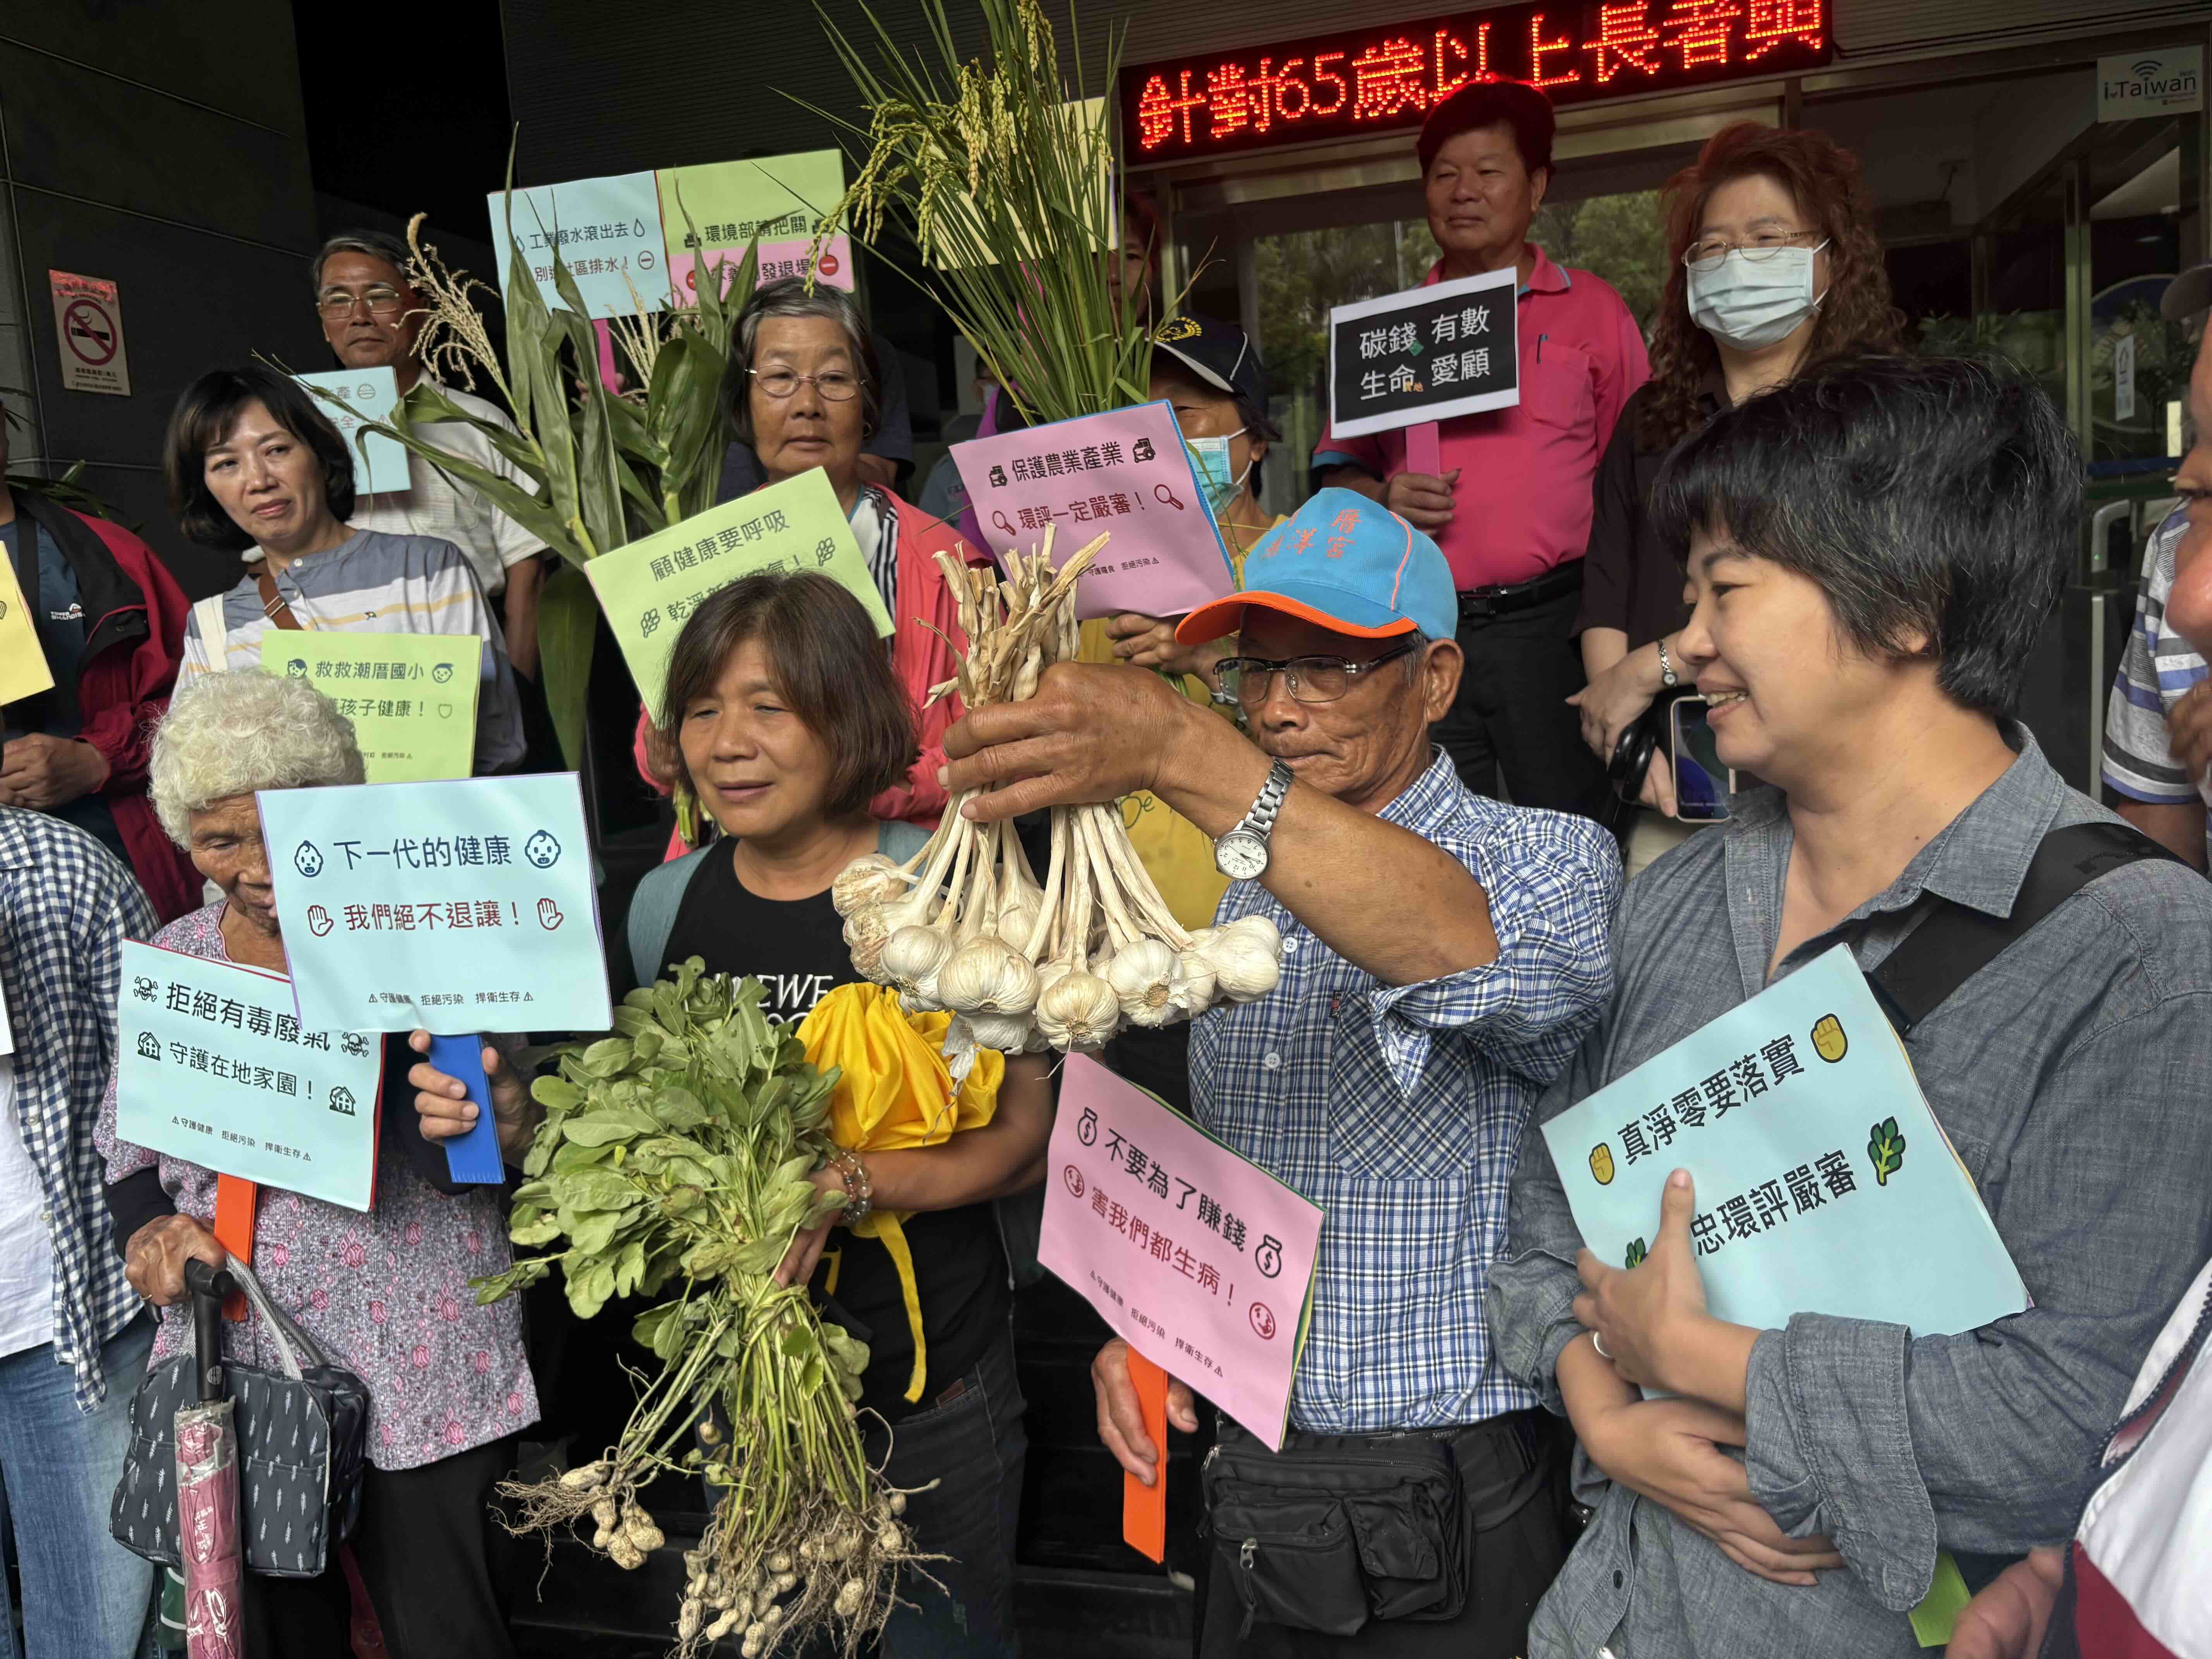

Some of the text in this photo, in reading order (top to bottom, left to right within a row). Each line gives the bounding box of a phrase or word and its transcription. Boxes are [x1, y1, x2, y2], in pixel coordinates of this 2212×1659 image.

[704, 216, 807, 243] 環境部請把關
[1359, 305, 1490, 359] 碳錢 有數
[1360, 347, 1491, 400] 生命 愛顧
[1012, 441, 1125, 482] 保護農業產業
[1019, 492, 1146, 530] 環評一定嚴審！
[649, 510, 790, 582] 顧健康要呼吸
[331, 697, 424, 717] 孩子健康！
[333, 835, 512, 871] 下一代的健康
[343, 900, 520, 931] 我們絕不退讓！
[166, 982, 330, 1051] 拒絕有毒廢氣
[421, 994, 465, 1006] 拒絕污染
[475, 991, 521, 1004] 捍衛生存
[169, 1041, 313, 1100] 守護在地家園！
[1617, 1034, 1805, 1166] 真淨零要落實
[181, 1118, 301, 1159] 守護健康 拒絕污染 捍衛生存
[1104, 1128, 1247, 1252] 不要為了賺錢
[1689, 1149, 1857, 1257] 忠環評嚴審
[1091, 1186, 1234, 1307] 害我們都生病！
[1130, 1307, 1166, 1339] 拒絕污染
[1175, 1337, 1214, 1369] 捍衛生存
